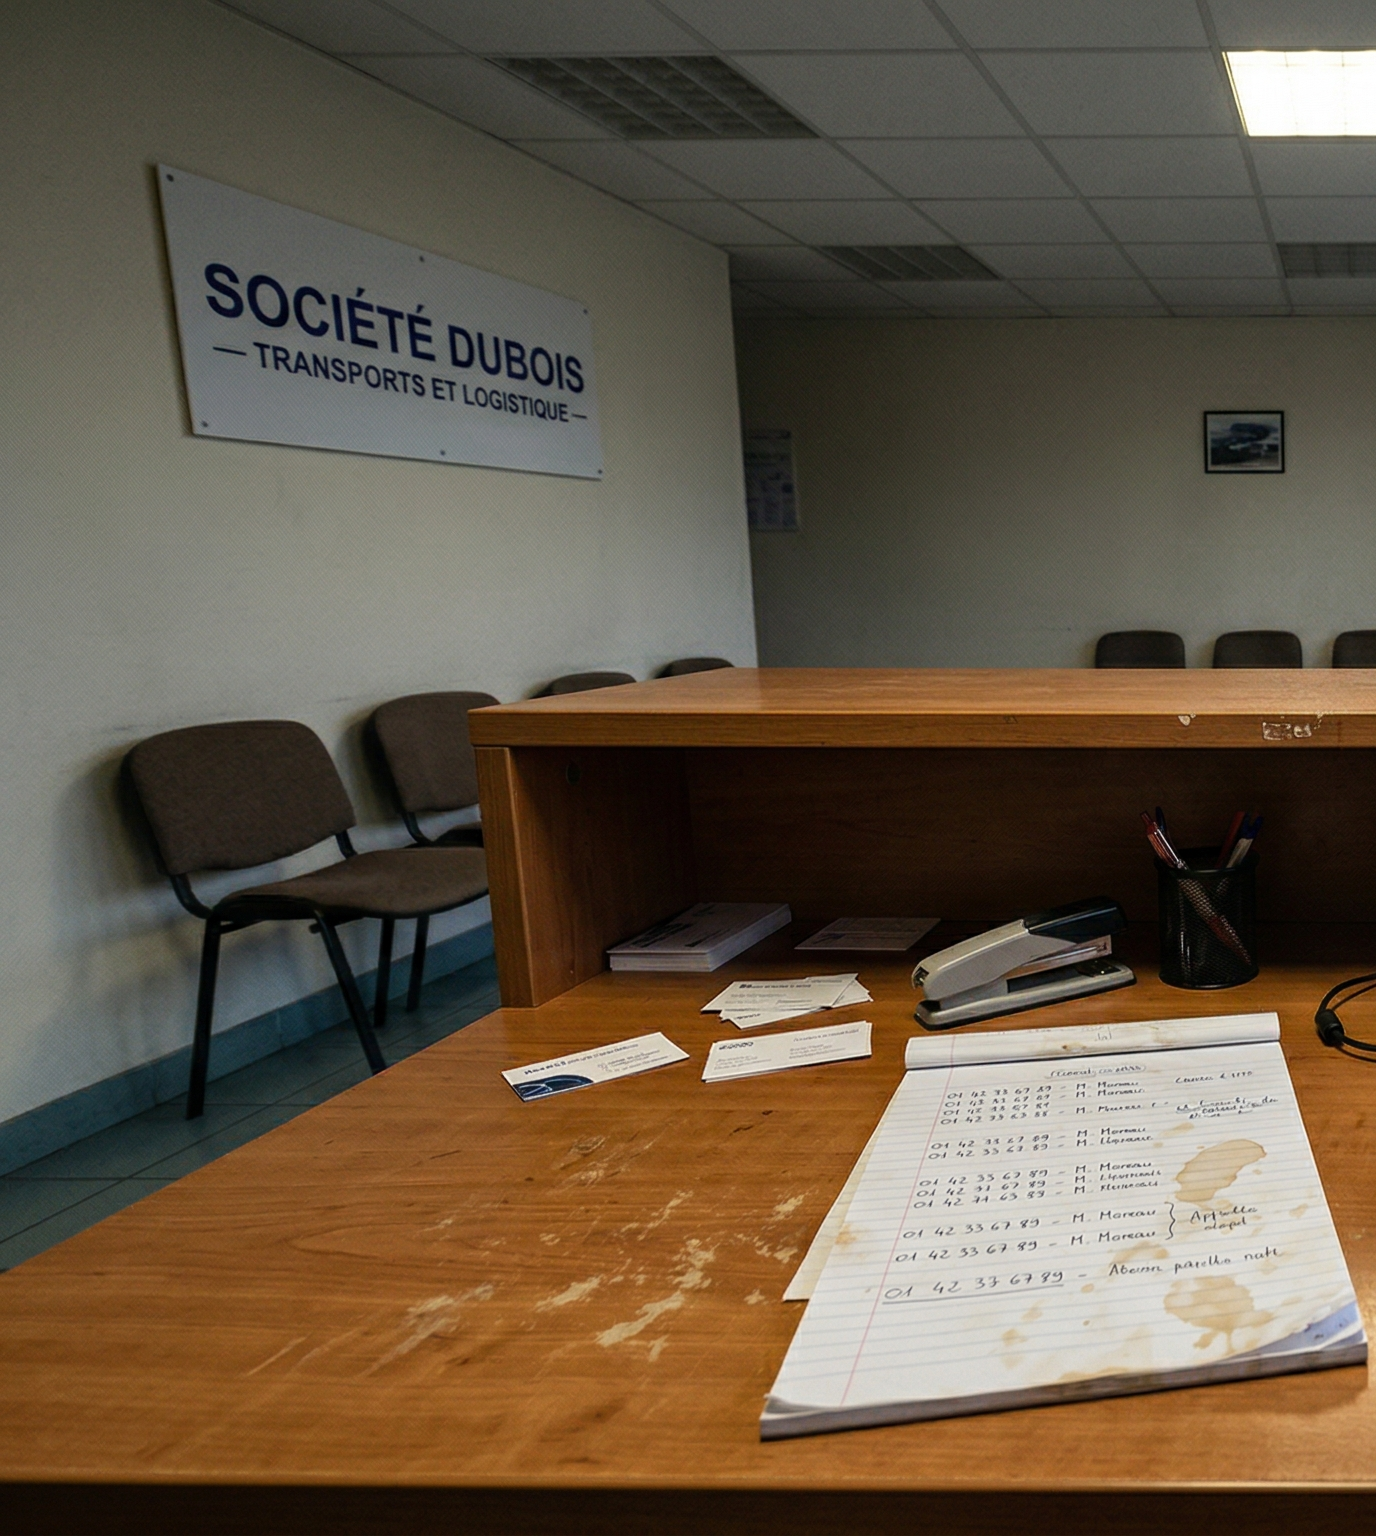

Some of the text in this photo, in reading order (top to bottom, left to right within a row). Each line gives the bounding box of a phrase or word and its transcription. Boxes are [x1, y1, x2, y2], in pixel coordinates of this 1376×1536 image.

[203, 263, 585, 394] SOCIÉTÉ DUBOIS
[252, 341, 570, 422] TRANSPORTS ET LOGISTIQUE
[903, 1229, 923, 1239] 01
[934, 1226, 956, 1237] 42
[895, 1252, 917, 1262] 01
[928, 1250, 950, 1260] 42
[884, 1286, 913, 1300] 01
[932, 1281, 962, 1294] 42
